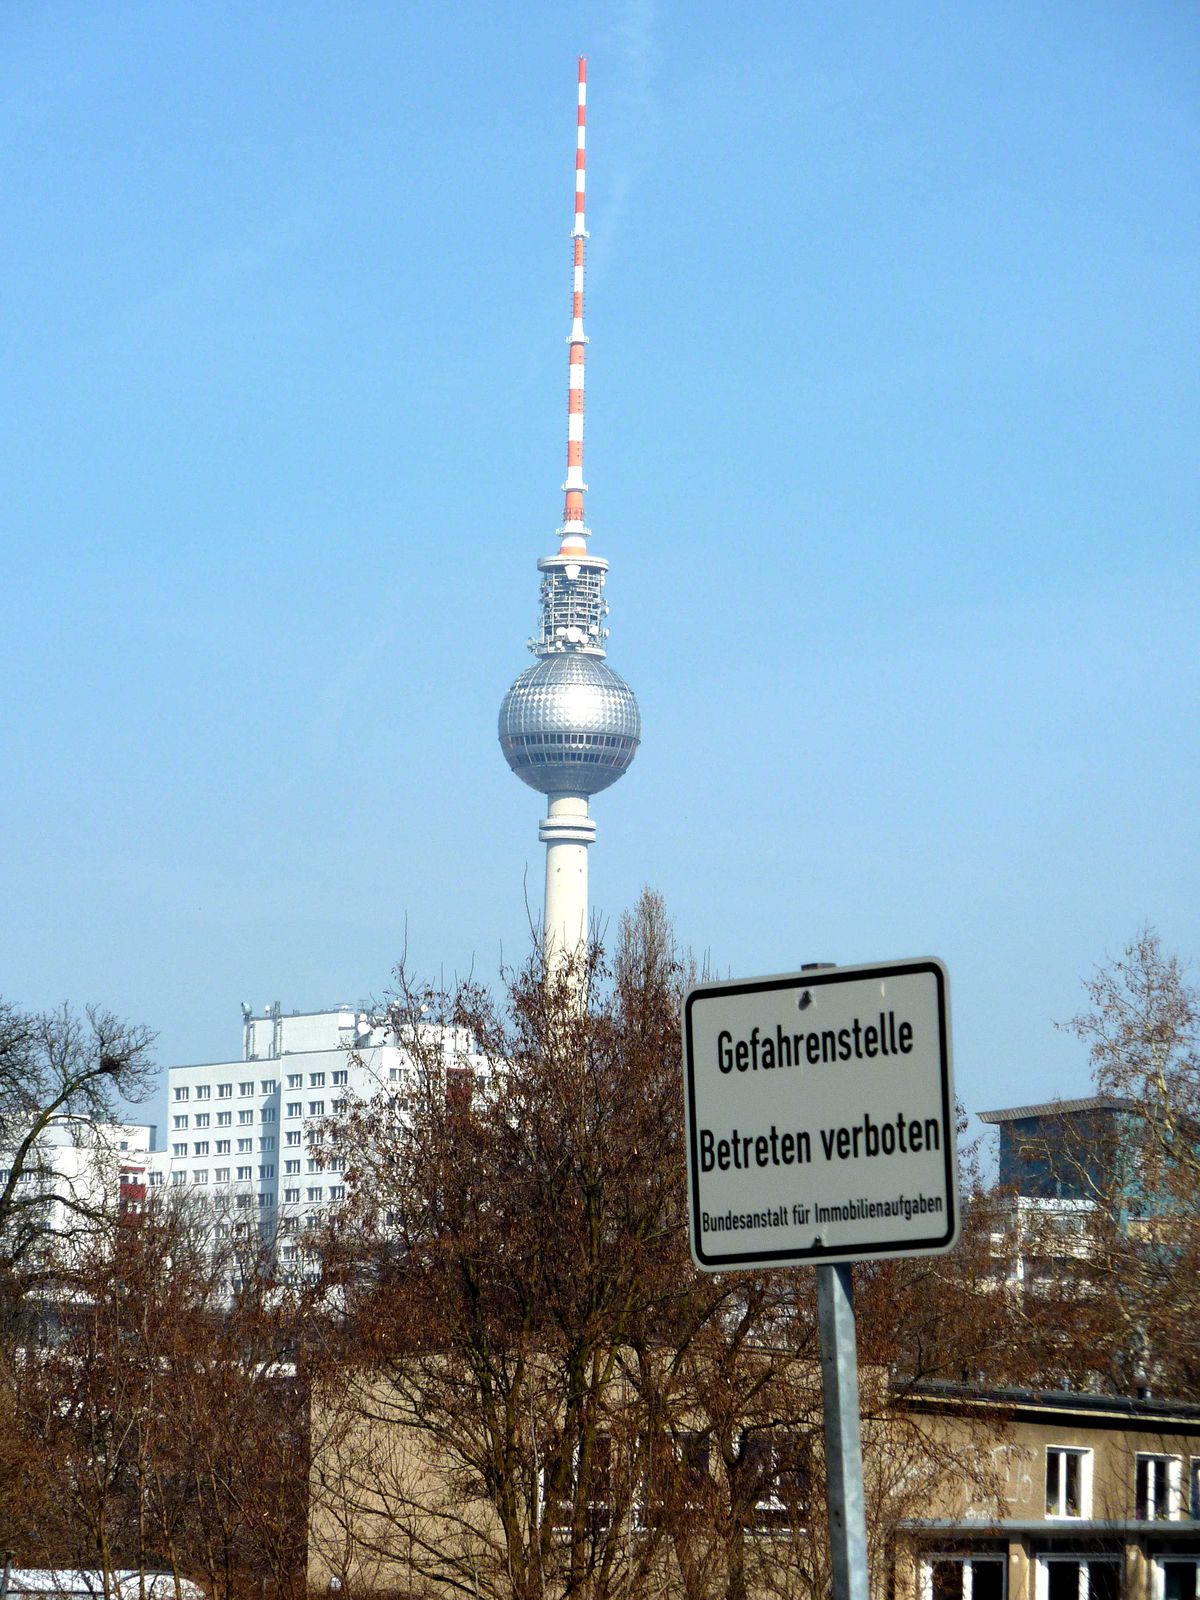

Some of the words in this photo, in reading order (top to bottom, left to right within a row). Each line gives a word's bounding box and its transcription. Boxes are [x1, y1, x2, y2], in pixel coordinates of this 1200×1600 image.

[718, 1011, 913, 1074] Gefahrenstelle
[700, 1126, 812, 1172] Betreten
[820, 1113, 940, 1161] verboten
[702, 1206, 789, 1233] Bundesanstalt
[792, 1204, 811, 1225] für
[815, 1193, 943, 1223] Immobilienaufgaben
